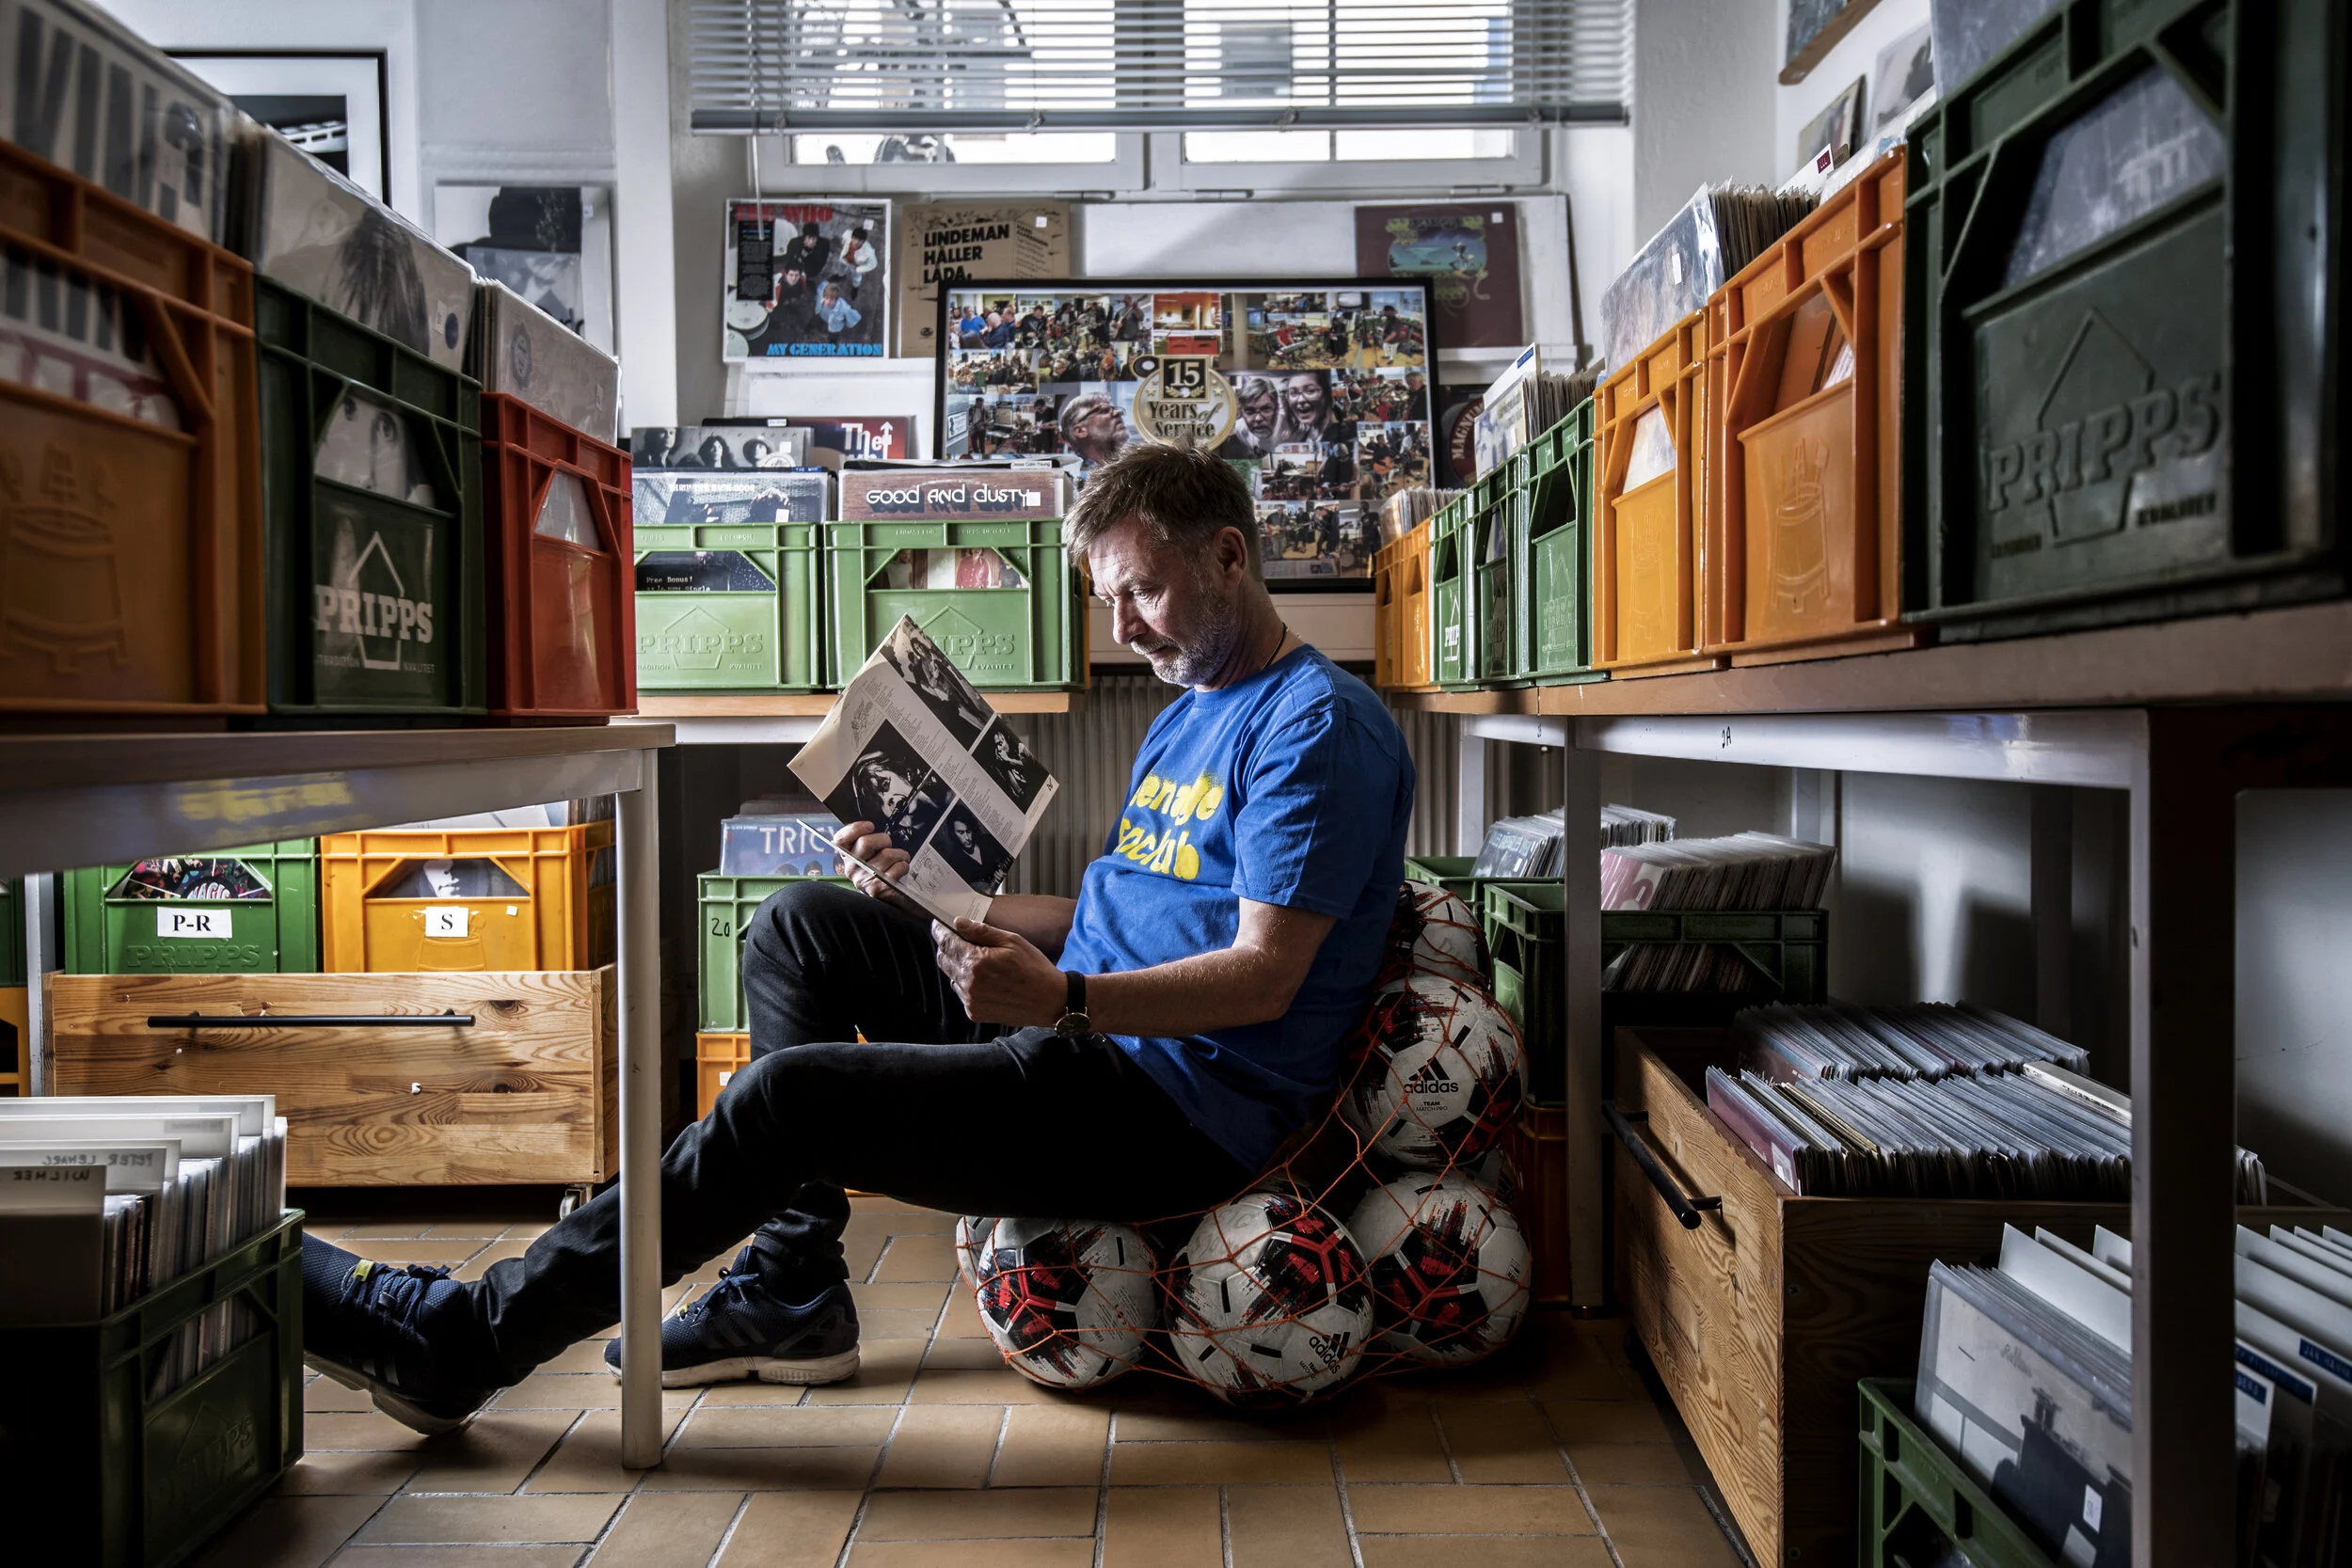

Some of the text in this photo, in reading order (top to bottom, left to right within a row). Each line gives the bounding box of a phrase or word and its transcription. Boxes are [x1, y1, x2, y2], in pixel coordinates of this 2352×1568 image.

[783, 205, 834, 223] WHO
[924, 224, 1009, 247] LINDEMAN
[766, 343, 882, 356] MY GENERATION
[1168, 361, 1200, 387] 15
[1149, 401, 1223, 423] Years of
[1988, 374, 2224, 513] PRIPPS
[314, 583, 434, 643] PRIPPS
[636, 632, 764, 655] PRIPPS
[932, 633, 1015, 656] IPPS
[172, 914, 212, 933] P-R
[440, 913, 453, 930] S
[126, 944, 261, 969] PRIPPS
[1404, 1079, 1459, 1095] adidas
[1309, 1335, 1341, 1374] adidas
